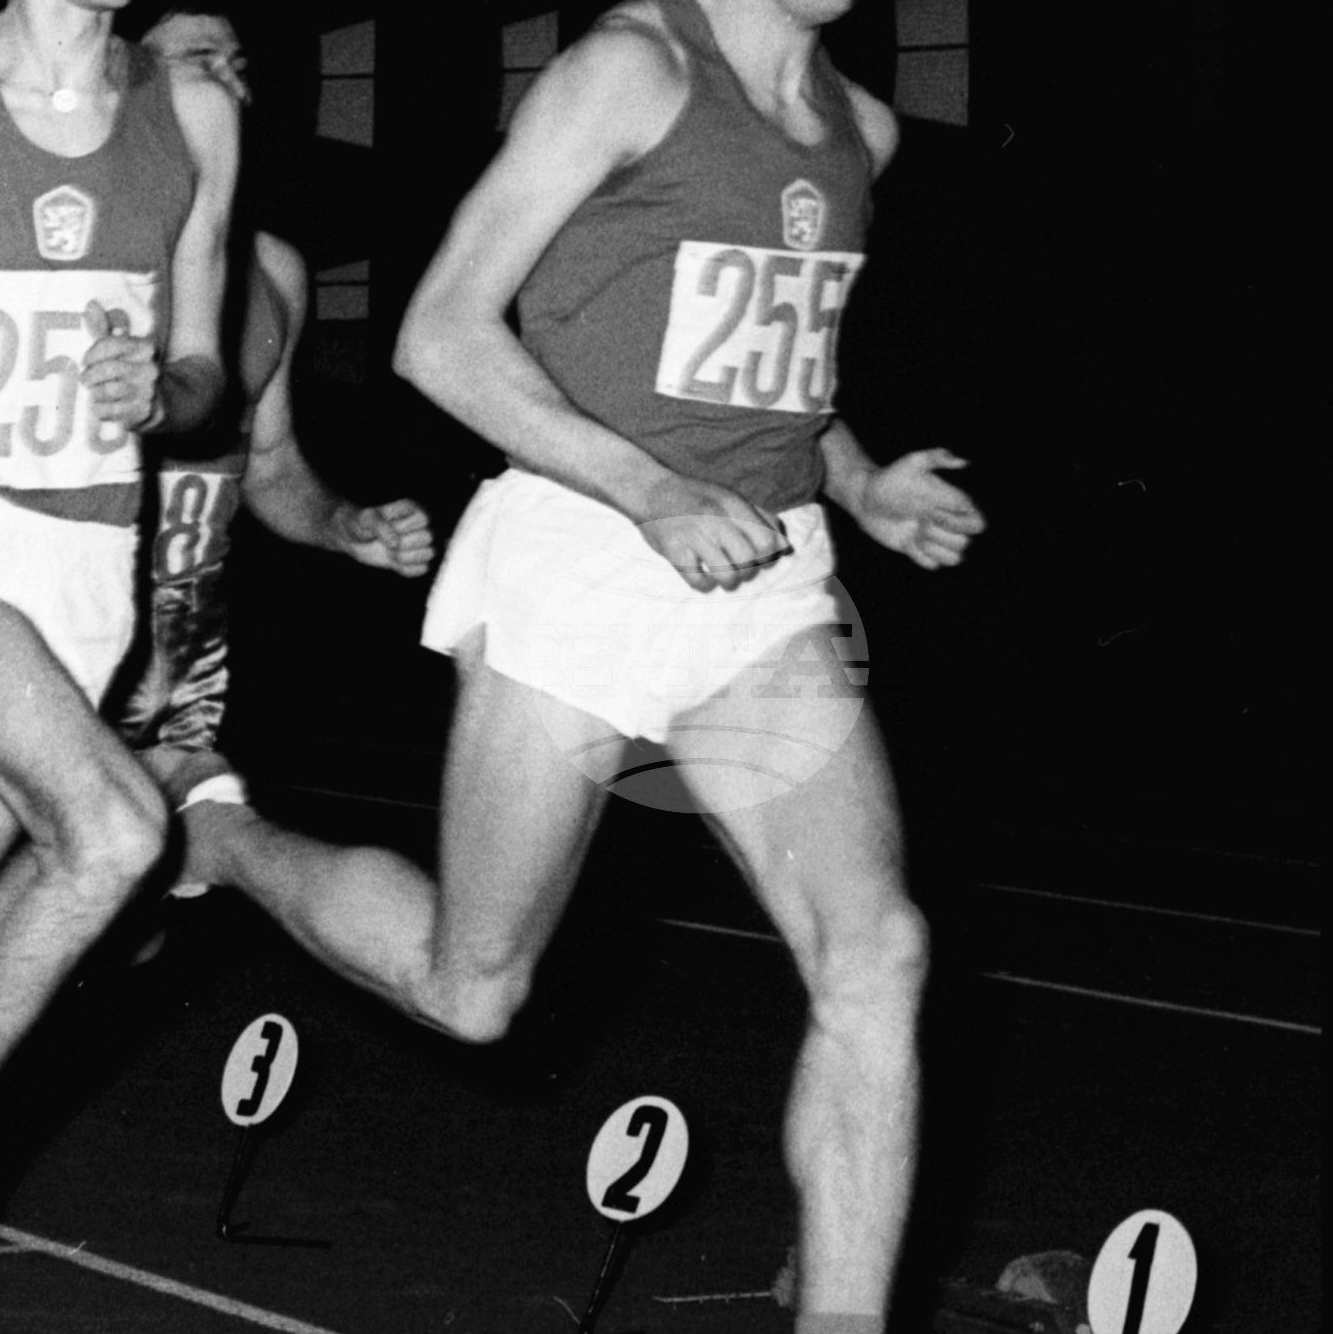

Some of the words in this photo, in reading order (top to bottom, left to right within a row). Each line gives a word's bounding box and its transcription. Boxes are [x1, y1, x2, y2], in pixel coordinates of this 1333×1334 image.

[680, 248, 848, 410] 255
[236, 1020, 284, 1118] 3
[601, 1104, 669, 1213] 2
